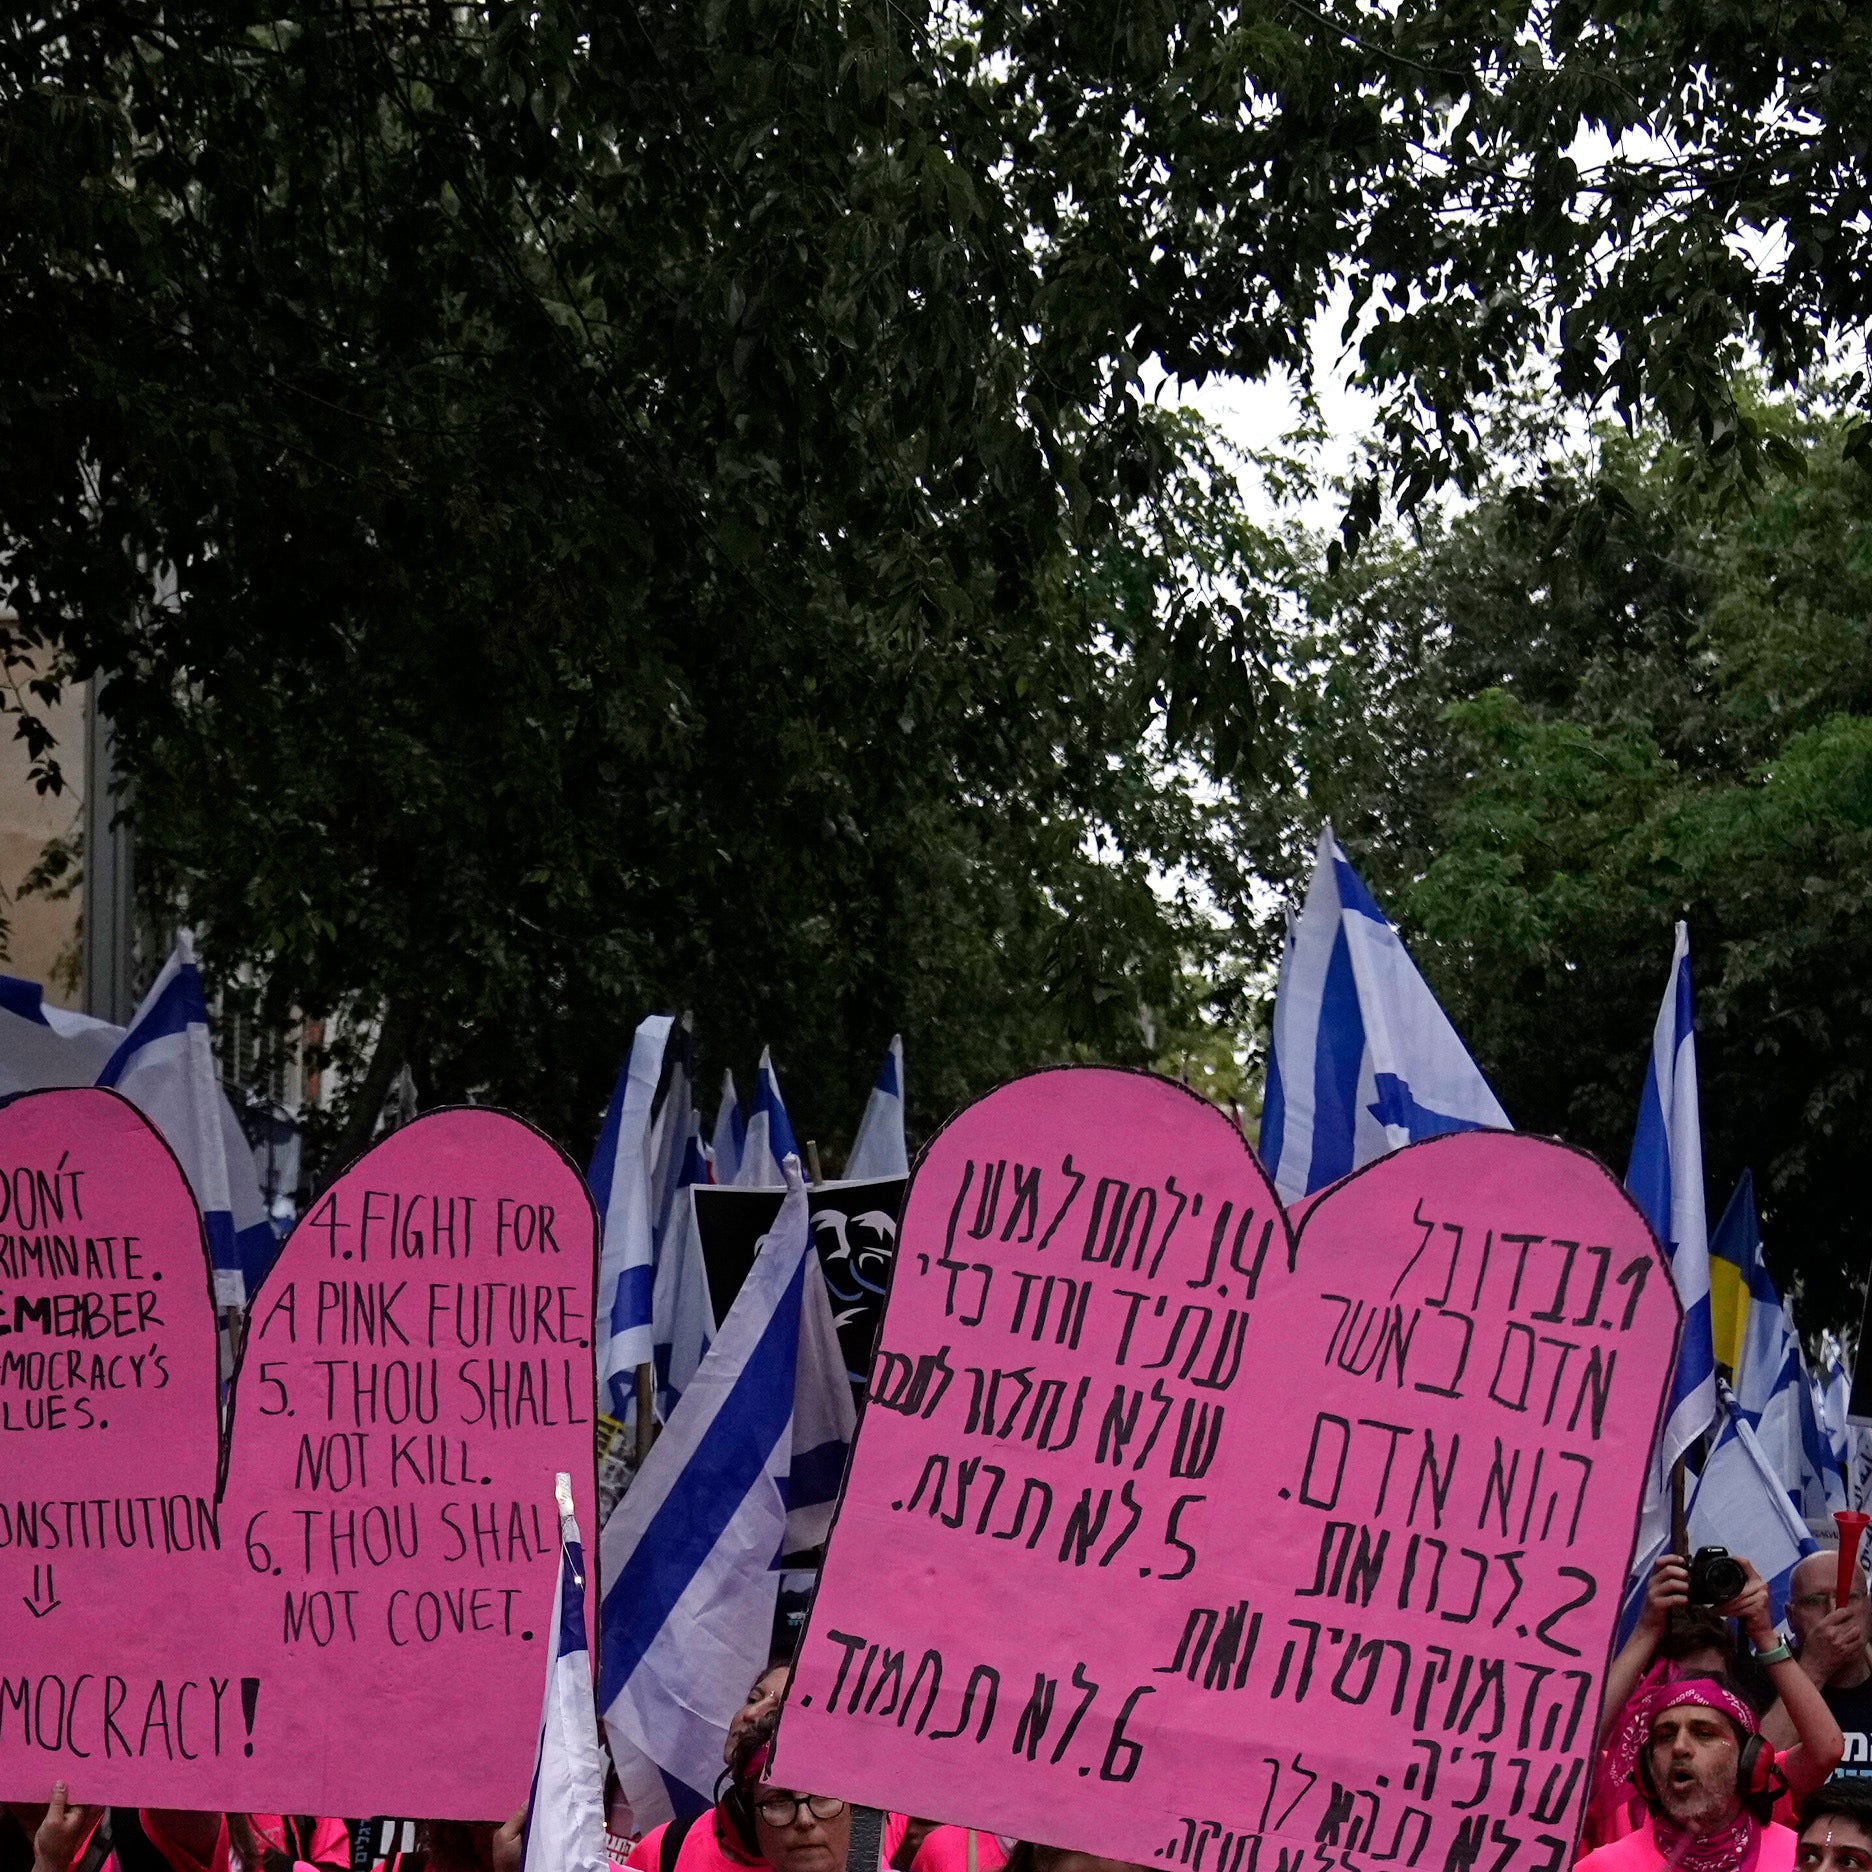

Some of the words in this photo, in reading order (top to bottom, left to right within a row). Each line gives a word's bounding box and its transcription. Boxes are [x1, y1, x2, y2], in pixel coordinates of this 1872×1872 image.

[497, 1198, 560, 1256] FOR
[259, 1285, 296, 1342] A
[317, 1283, 410, 1346] PINK
[428, 1283, 589, 1349] FUTURE.
[1114, 1285, 1249, 1395] עתיד
[1321, 1288, 1474, 1399] באשר
[315, 1359, 439, 1427] THOU
[459, 1358, 587, 1429] SHALL
[1095, 1373, 1229, 1479] שלא
[1489, 1315, 1617, 1440] אדם
[295, 1432, 368, 1493] NOT
[391, 1434, 492, 1487] KILL.
[1278, 1412, 1460, 1534] אדם.
[1478, 1437, 1593, 1546] הוא
[296, 1505, 418, 1571] THOU
[441, 1502, 585, 1571] SHAL
[284, 1590, 358, 1647] NOT
[388, 1588, 534, 1646] COVET.
[1271, 1613, 1593, 1758] הדמוקרטיה
